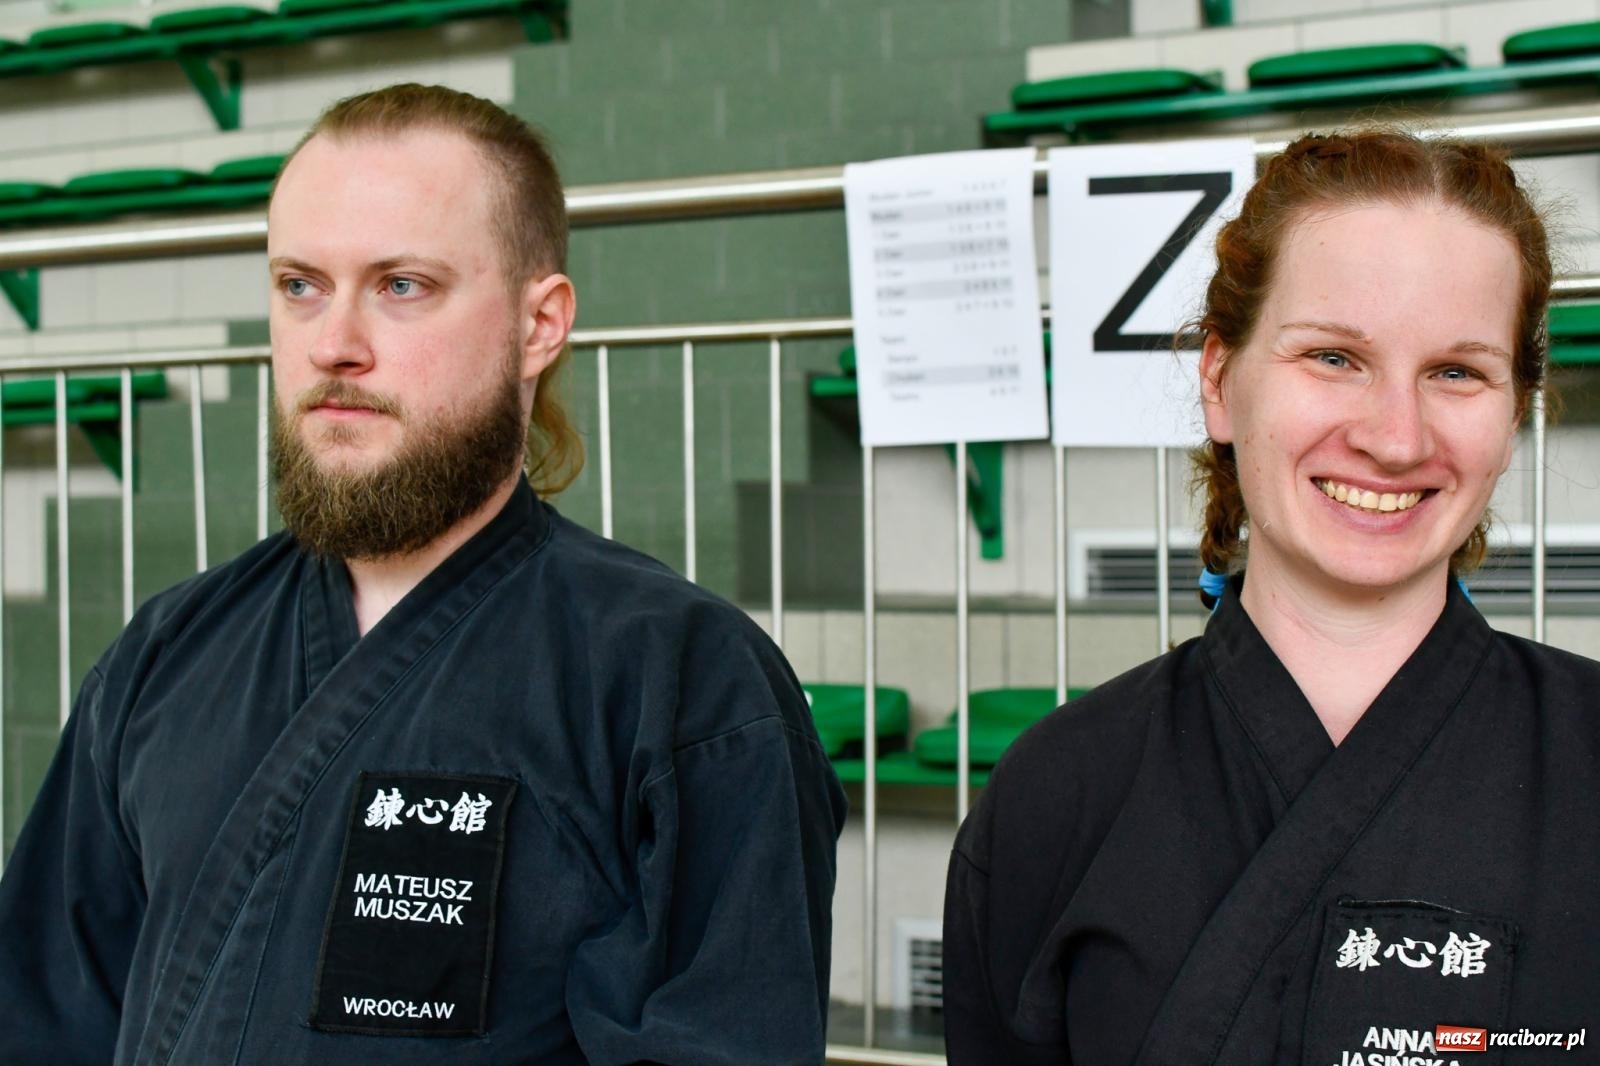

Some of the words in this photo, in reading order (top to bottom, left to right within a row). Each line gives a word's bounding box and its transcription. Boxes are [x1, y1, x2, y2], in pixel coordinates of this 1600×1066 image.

[1088, 171, 1233, 352] Z
[353, 873, 474, 901] MATEUSZ
[353, 897, 464, 925] MUSZAK
[343, 996, 455, 1019] WROCŁAW
[1362, 1026, 1438, 1056] ANNA
[1333, 1050, 1461, 1066] JASIŃ
